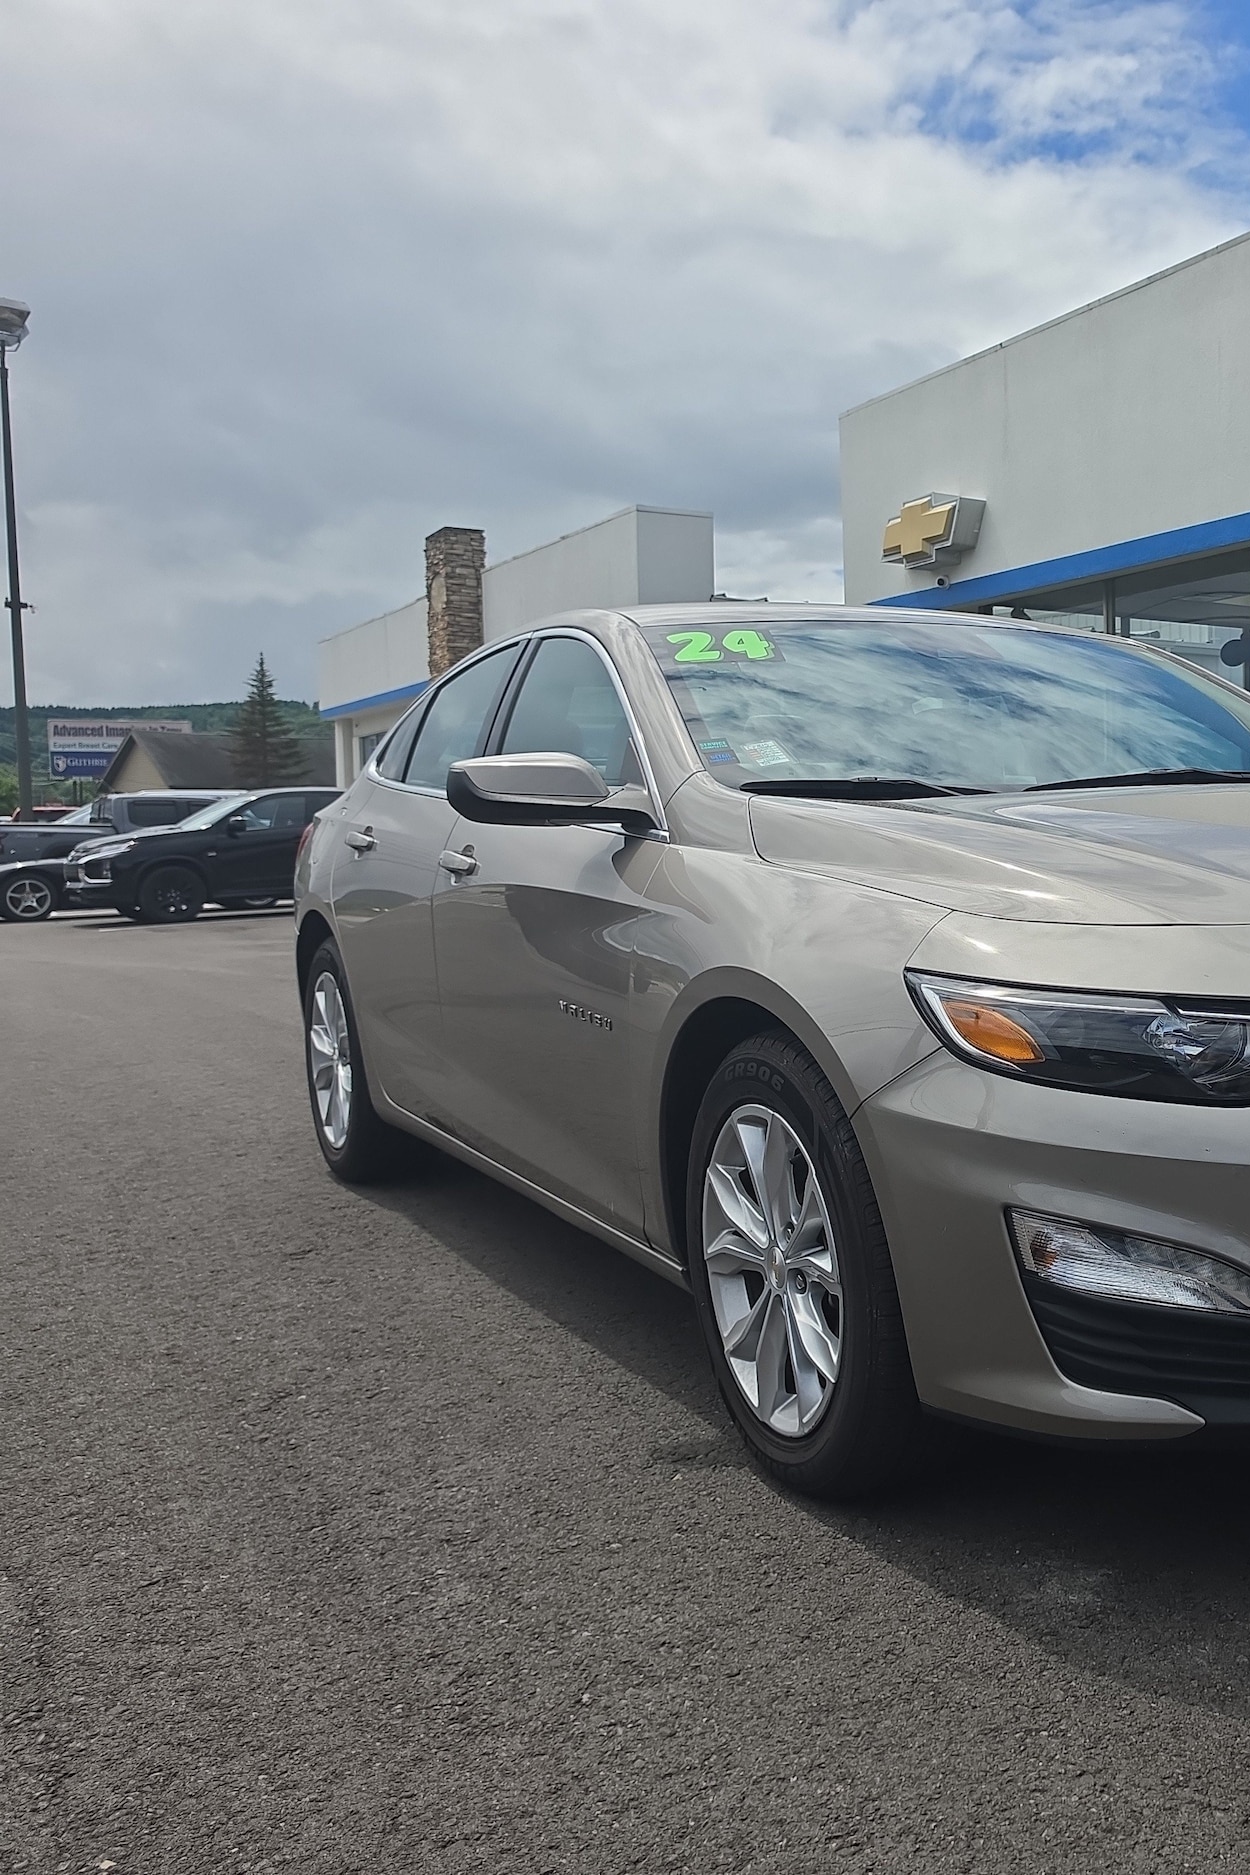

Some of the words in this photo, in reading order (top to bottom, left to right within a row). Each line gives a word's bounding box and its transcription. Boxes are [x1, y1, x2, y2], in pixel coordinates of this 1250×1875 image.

[666, 629, 775, 662] 24
[53, 724, 104, 738] Advanced
[53, 742, 77, 750] Expert
[724, 1062, 785, 1092] GR906
